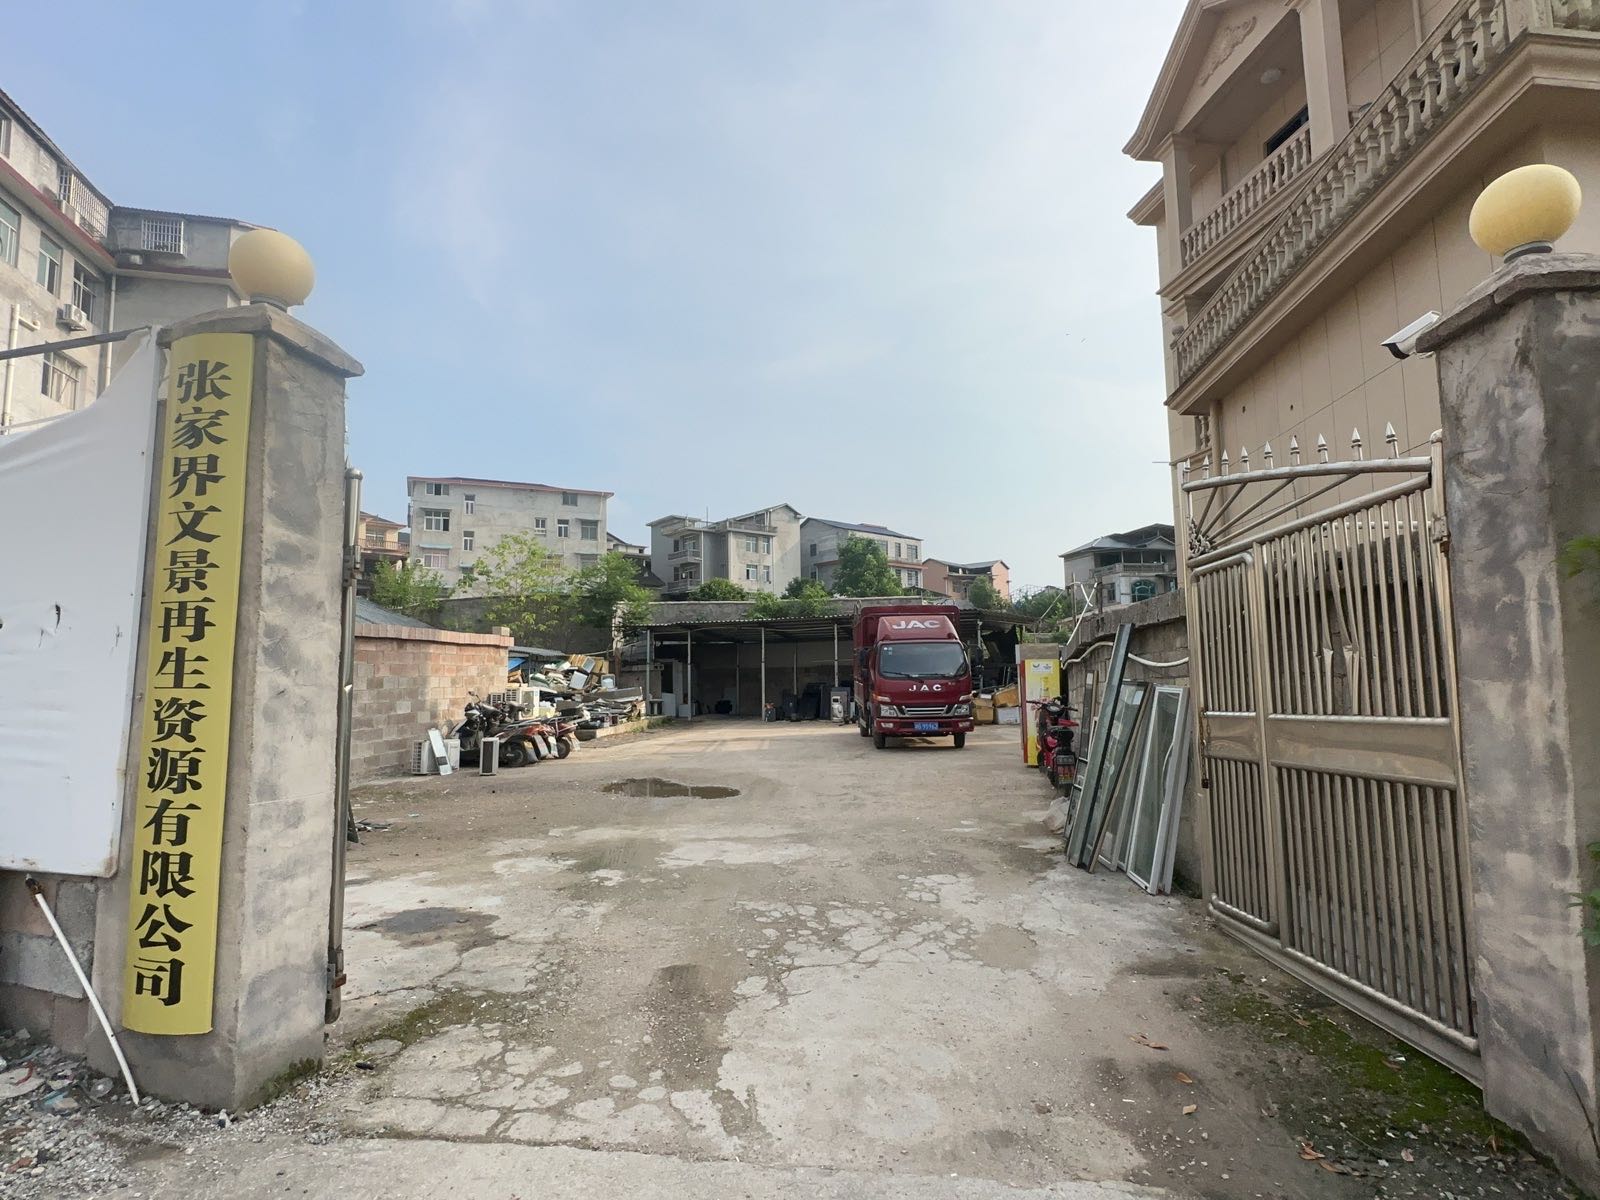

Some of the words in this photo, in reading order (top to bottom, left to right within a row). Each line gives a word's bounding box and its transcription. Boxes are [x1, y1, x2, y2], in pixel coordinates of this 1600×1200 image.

[133, 359, 233, 1006] 张家界文景再生资源有限公司
[892, 620, 940, 629] JAC
